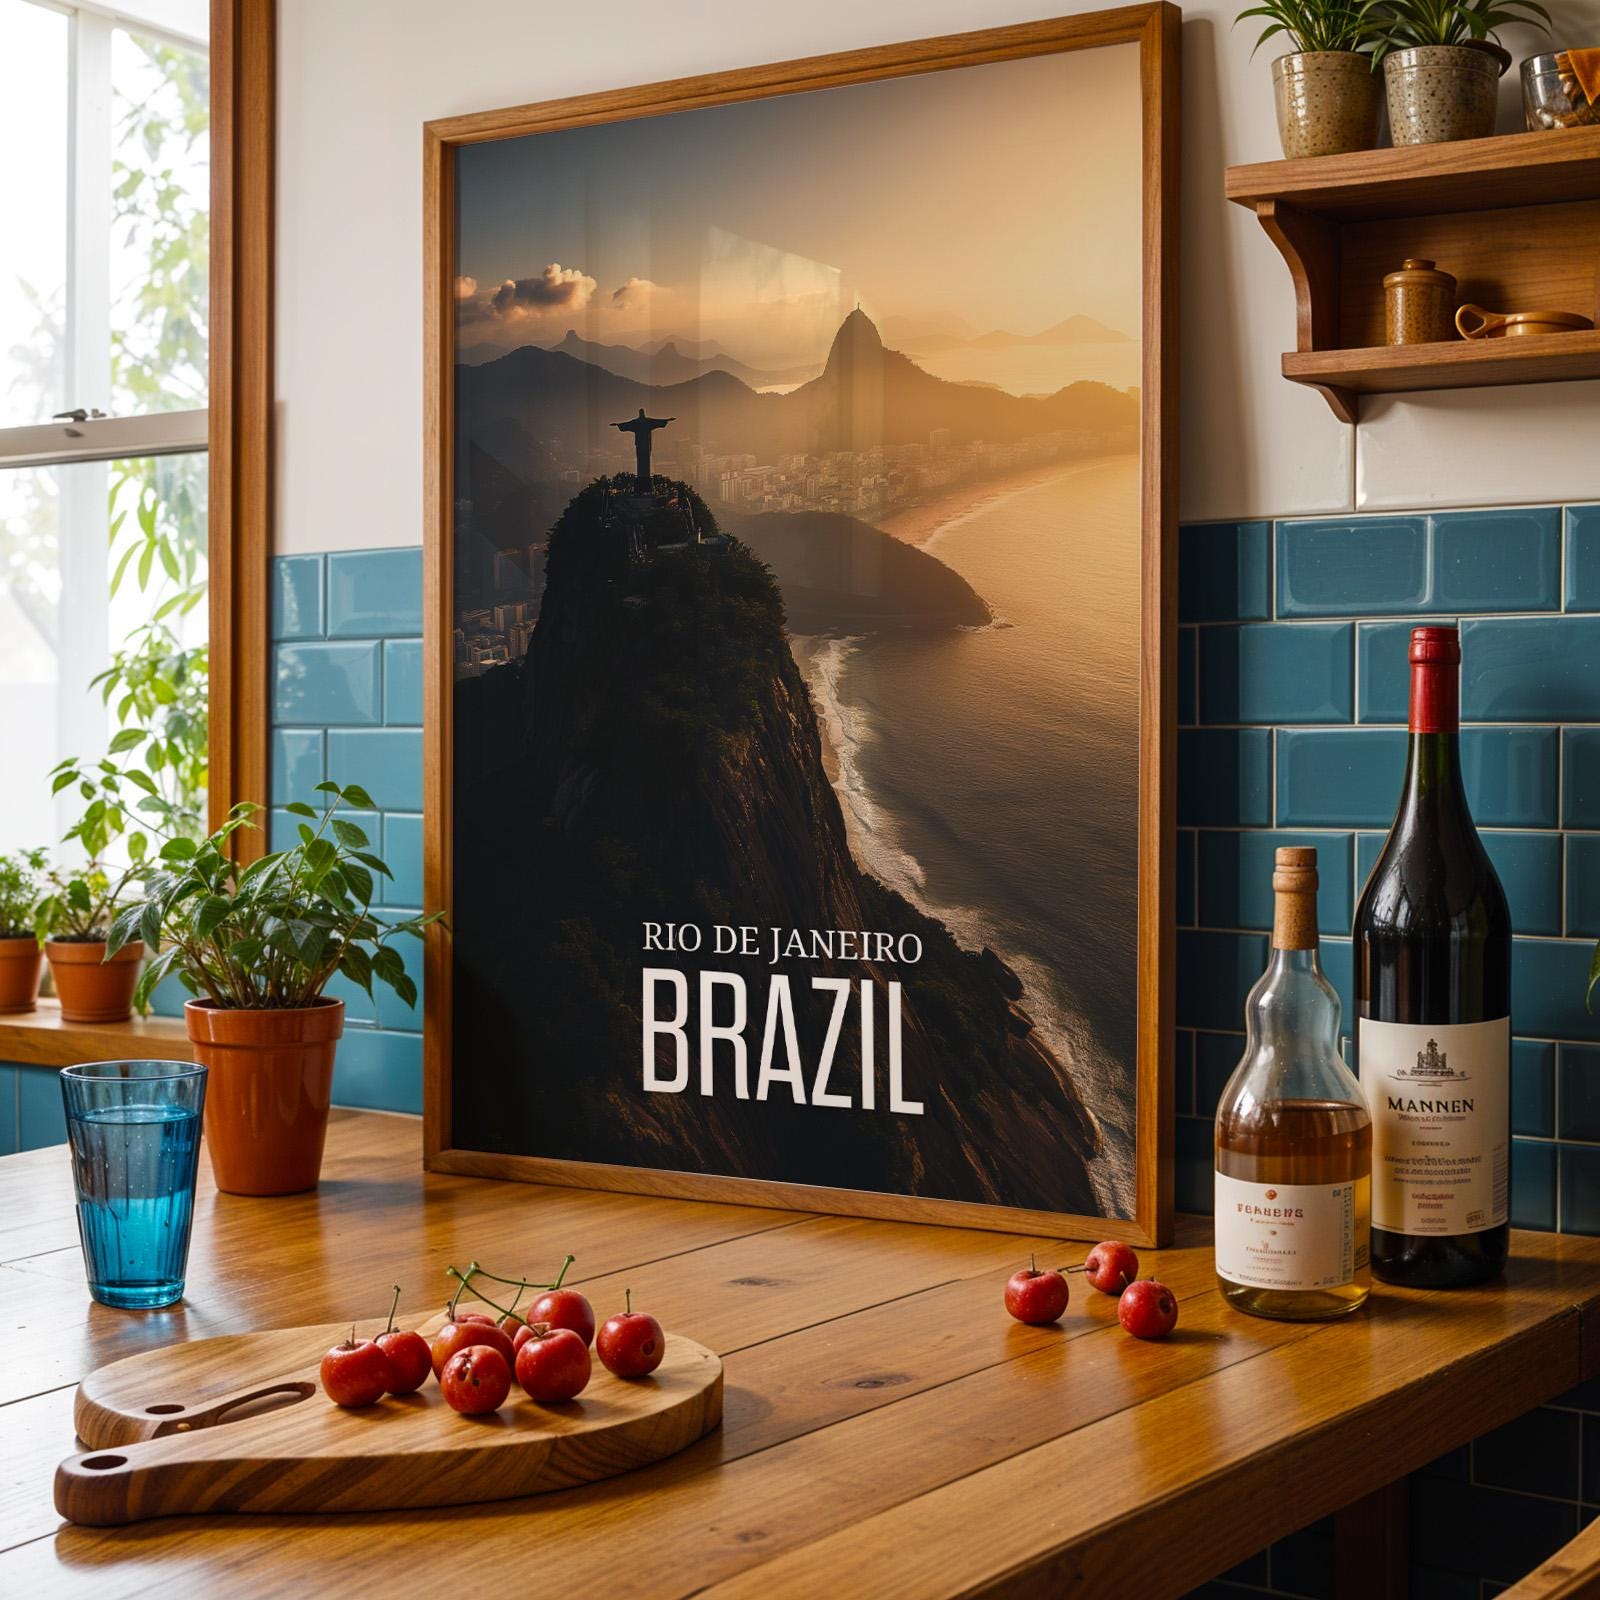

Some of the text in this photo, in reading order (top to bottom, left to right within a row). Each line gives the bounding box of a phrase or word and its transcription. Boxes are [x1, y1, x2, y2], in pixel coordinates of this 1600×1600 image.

[643, 922, 923, 964] RIO DE JANEIRO
[643, 967, 924, 1115] BRAZIL
[1388, 1096, 1475, 1113] MANNEN
